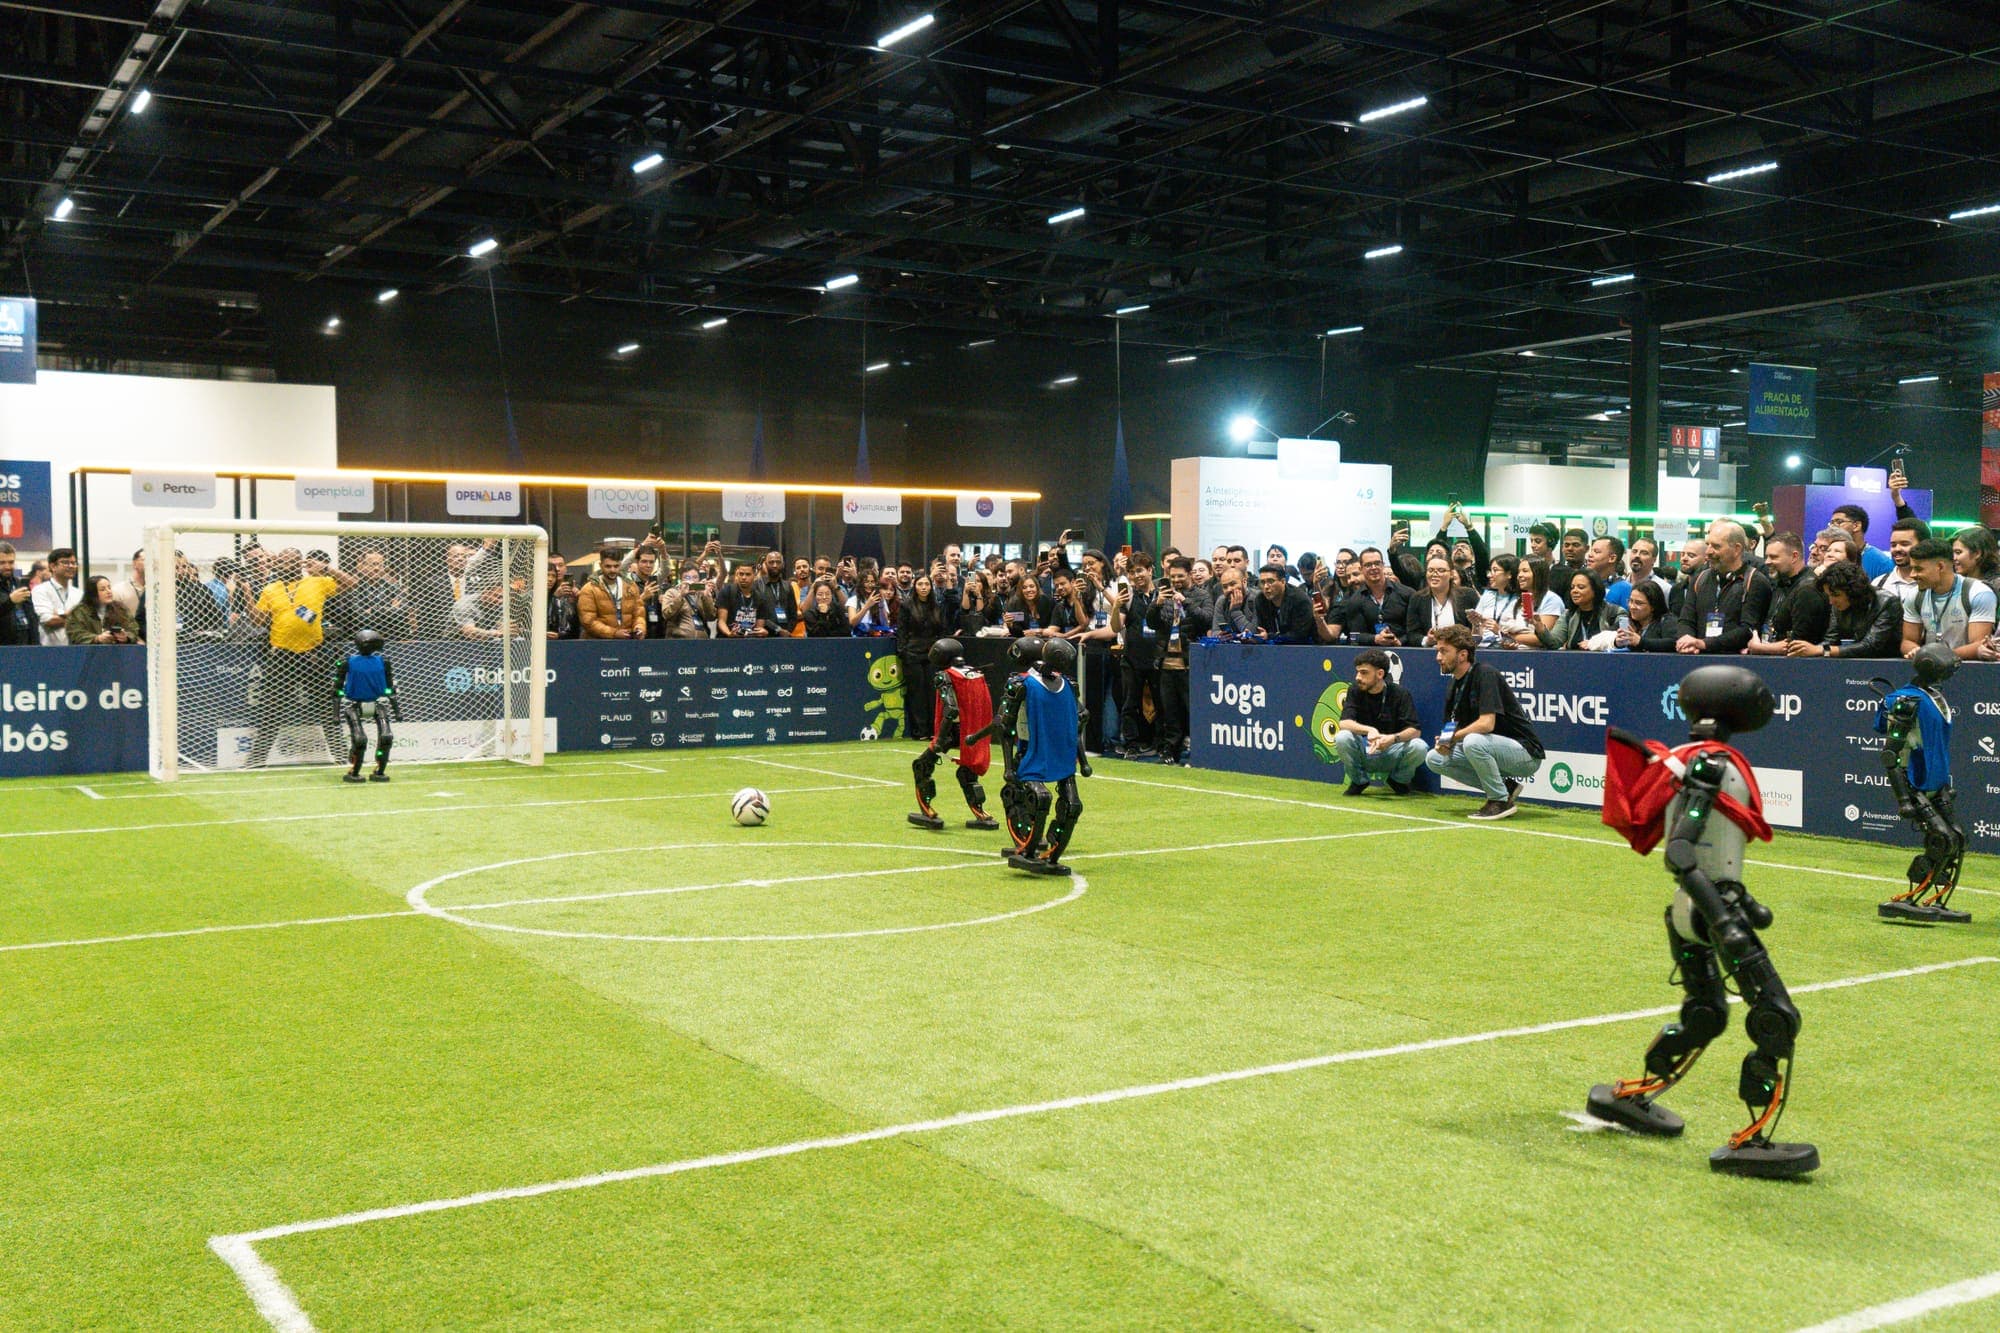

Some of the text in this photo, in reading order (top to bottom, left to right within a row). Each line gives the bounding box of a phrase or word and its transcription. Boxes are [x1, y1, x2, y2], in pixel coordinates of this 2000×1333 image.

[1763, 391, 1802, 404] PRAÇA DE
[1754, 404, 1810, 418] ALIMENTAÇÃO
[163, 482, 196, 494] Perto
[594, 488, 649, 502] noova
[618, 503, 649, 514] digital
[0, 682, 142, 712] leiro de
[777, 687, 793, 697] ed
[1210, 674, 1266, 715] Joga
[740, 709, 755, 718] blip
[1974, 702, 2000, 715] CI&
[0, 722, 69, 752] bôs
[721, 732, 754, 740] botmaker
[1211, 718, 1284, 751] muito!
[1986, 783, 2000, 794] fre
[1760, 791, 1792, 801] arthog
